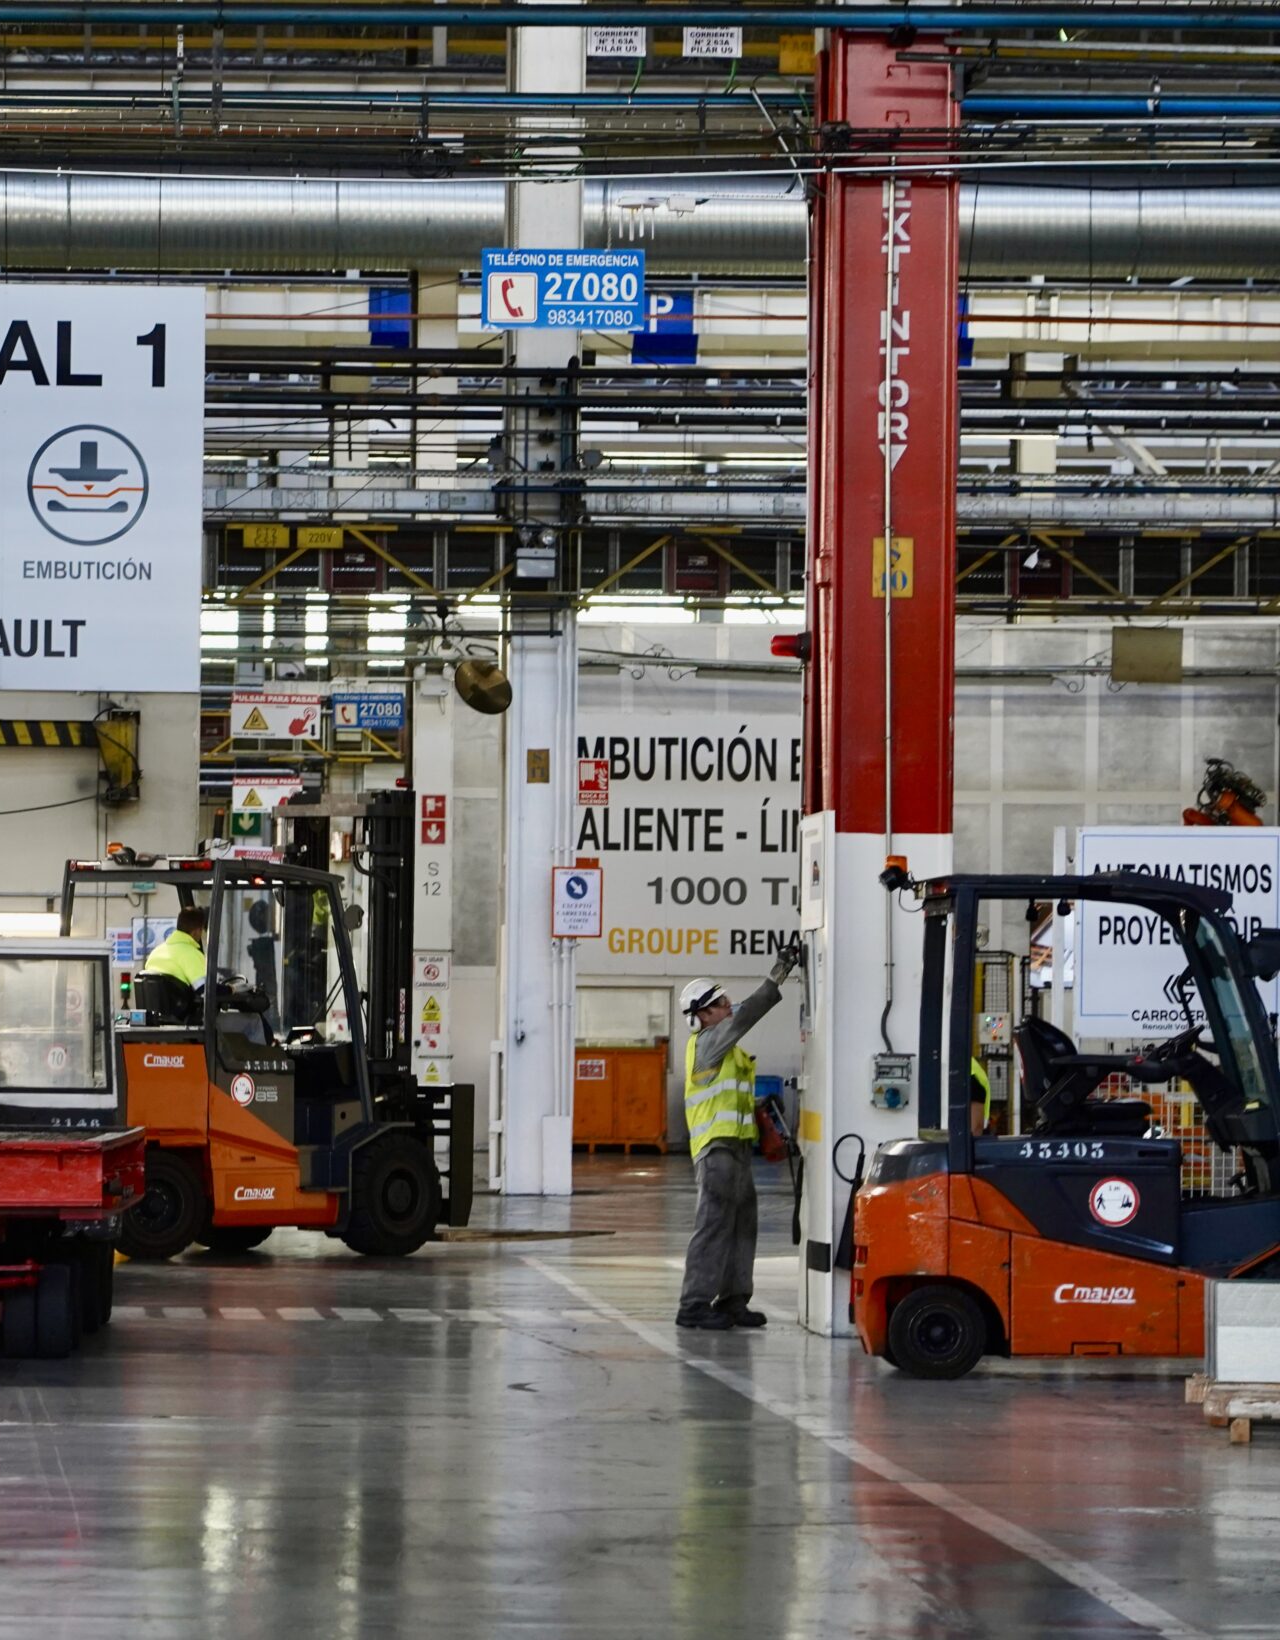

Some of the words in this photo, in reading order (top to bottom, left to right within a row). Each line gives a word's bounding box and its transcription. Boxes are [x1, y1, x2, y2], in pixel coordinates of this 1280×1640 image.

[487, 251, 546, 266] TELÉFONO
[548, 254, 564, 266] DE
[566, 254, 639, 267] EMERGENCIA
[543, 272, 638, 301] 27080
[547, 309, 633, 326] 983417080
[135, 322, 167, 388] 1
[22, 556, 153, 582] EMBUTICIÓN
[359, 702, 402, 716] 27080
[576, 807, 724, 852] ALIENTE
[427, 861, 439, 877] S
[423, 882, 441, 896] 12
[647, 876, 747, 906] 1000
[607, 927, 719, 955] GROUPE
[51, 1050, 64, 1065] 10
